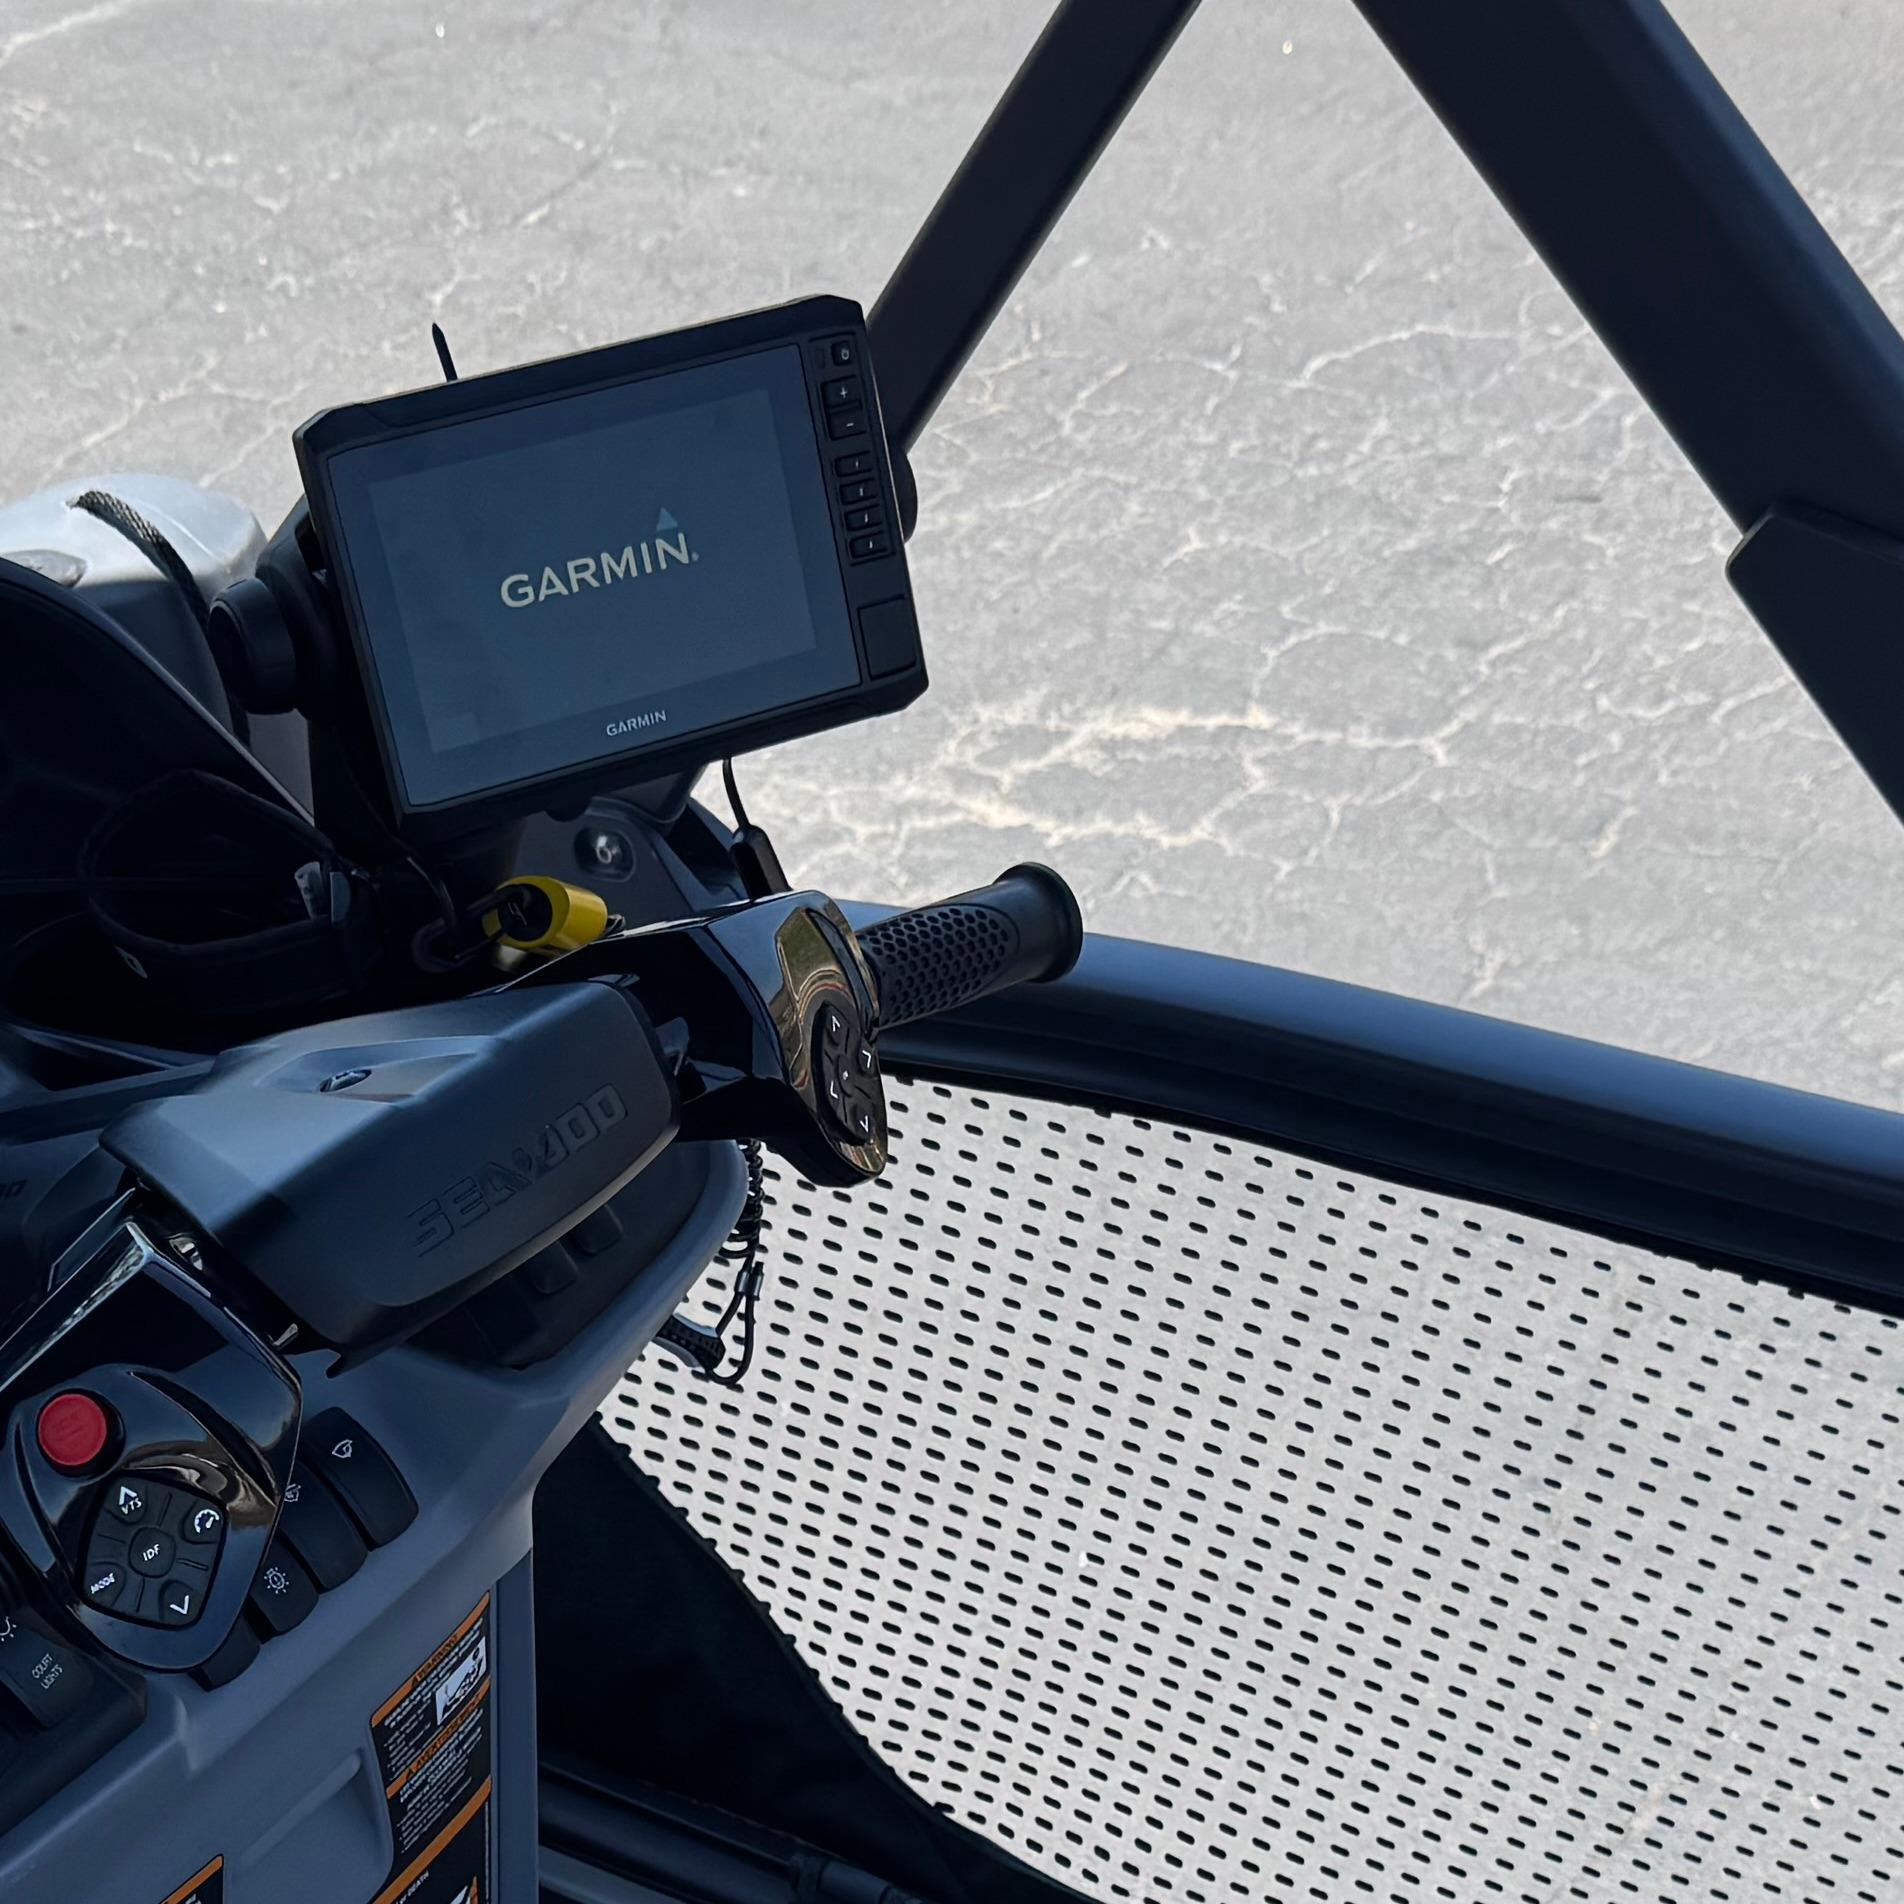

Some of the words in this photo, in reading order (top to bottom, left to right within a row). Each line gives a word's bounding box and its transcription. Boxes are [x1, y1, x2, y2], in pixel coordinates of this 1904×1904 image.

[500, 532, 690, 608] GARMIN
[606, 709, 667, 736] GARMIN
[121, 1497, 142, 1515] VTS
[142, 1543, 160, 1562] IDF
[90, 1572, 115, 1594] MODE
